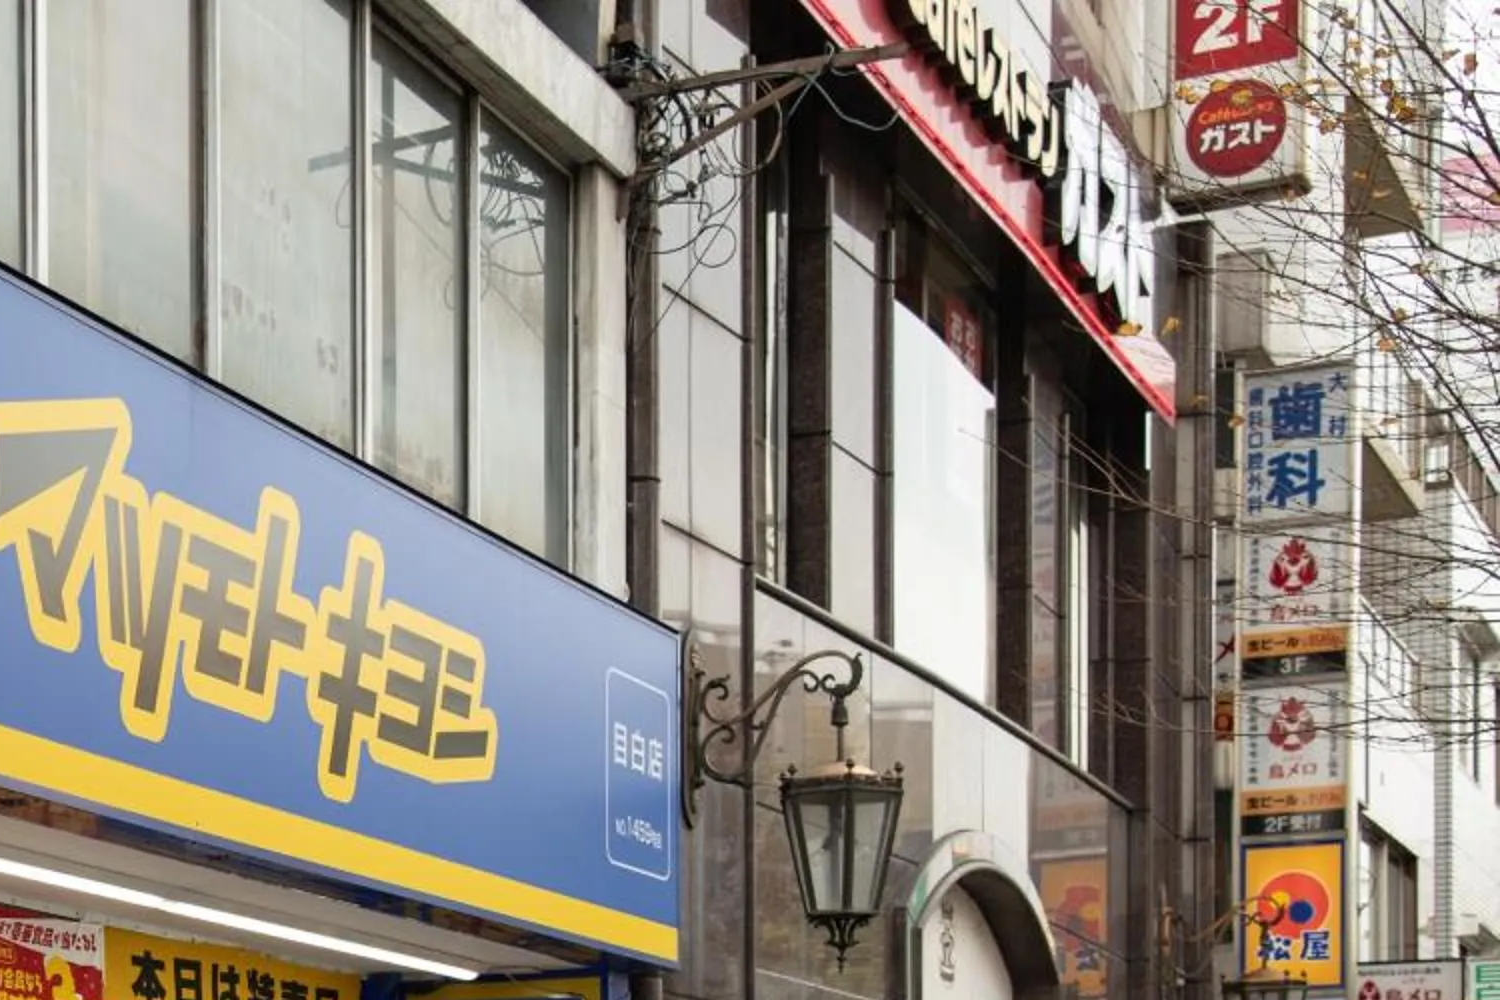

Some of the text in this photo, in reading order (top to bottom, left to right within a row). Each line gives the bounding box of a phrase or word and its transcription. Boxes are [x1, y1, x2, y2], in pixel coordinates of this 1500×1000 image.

[1193, 0, 1281, 55] 2F
[1200, 118, 1277, 153] ガスト
[1266, 382, 1326, 509] 歯科
[613, 721, 663, 783] 目白店
[1257, 931, 1330, 961] 松屋
